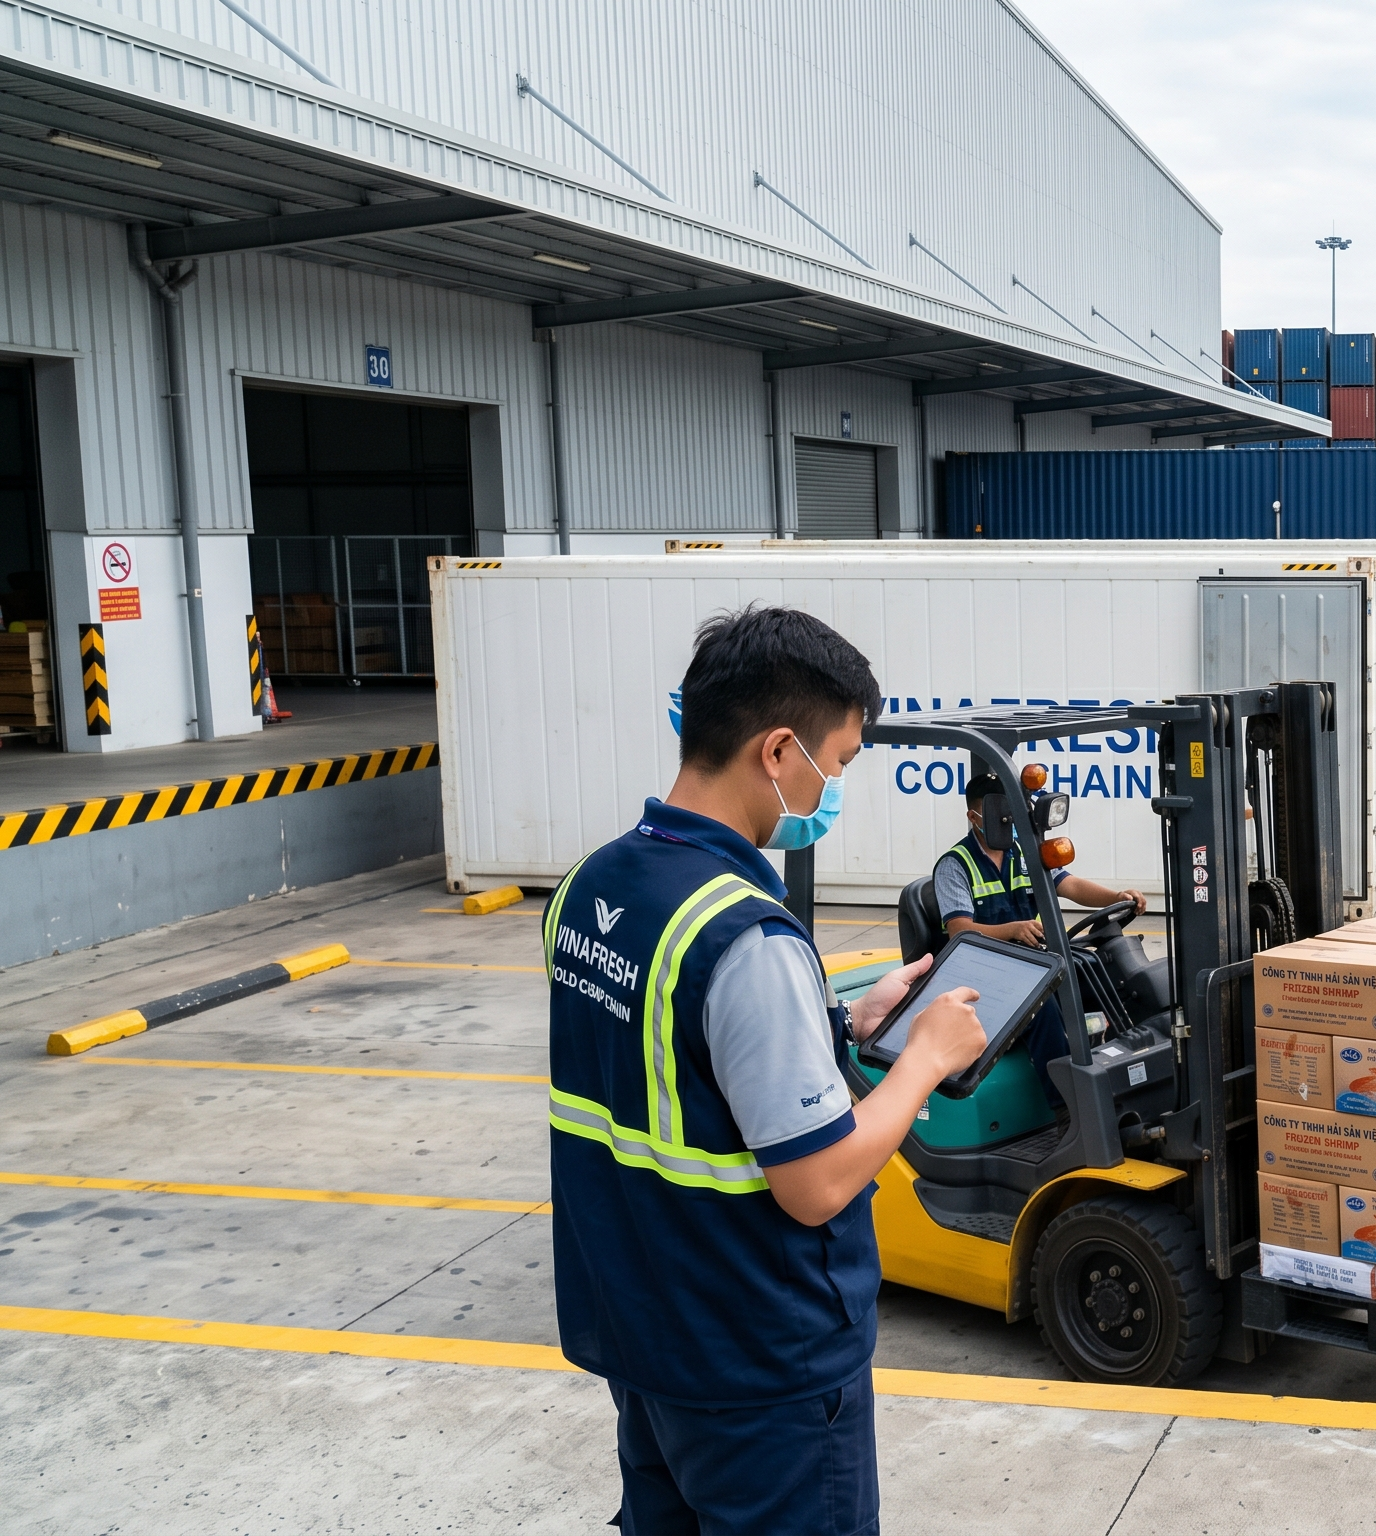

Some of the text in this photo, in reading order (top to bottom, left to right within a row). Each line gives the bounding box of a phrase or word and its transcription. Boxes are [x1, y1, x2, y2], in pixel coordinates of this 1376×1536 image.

[370, 355, 388, 379] 30
[896, 760, 1152, 799] COL HAIN
[557, 924, 639, 991] VINAFRESH
[552, 964, 578, 988] OLD
[1287, 970, 1298, 980] TY
[1289, 1119, 1299, 1129] TY
[1324, 1138, 1359, 1151] SHRIMP
